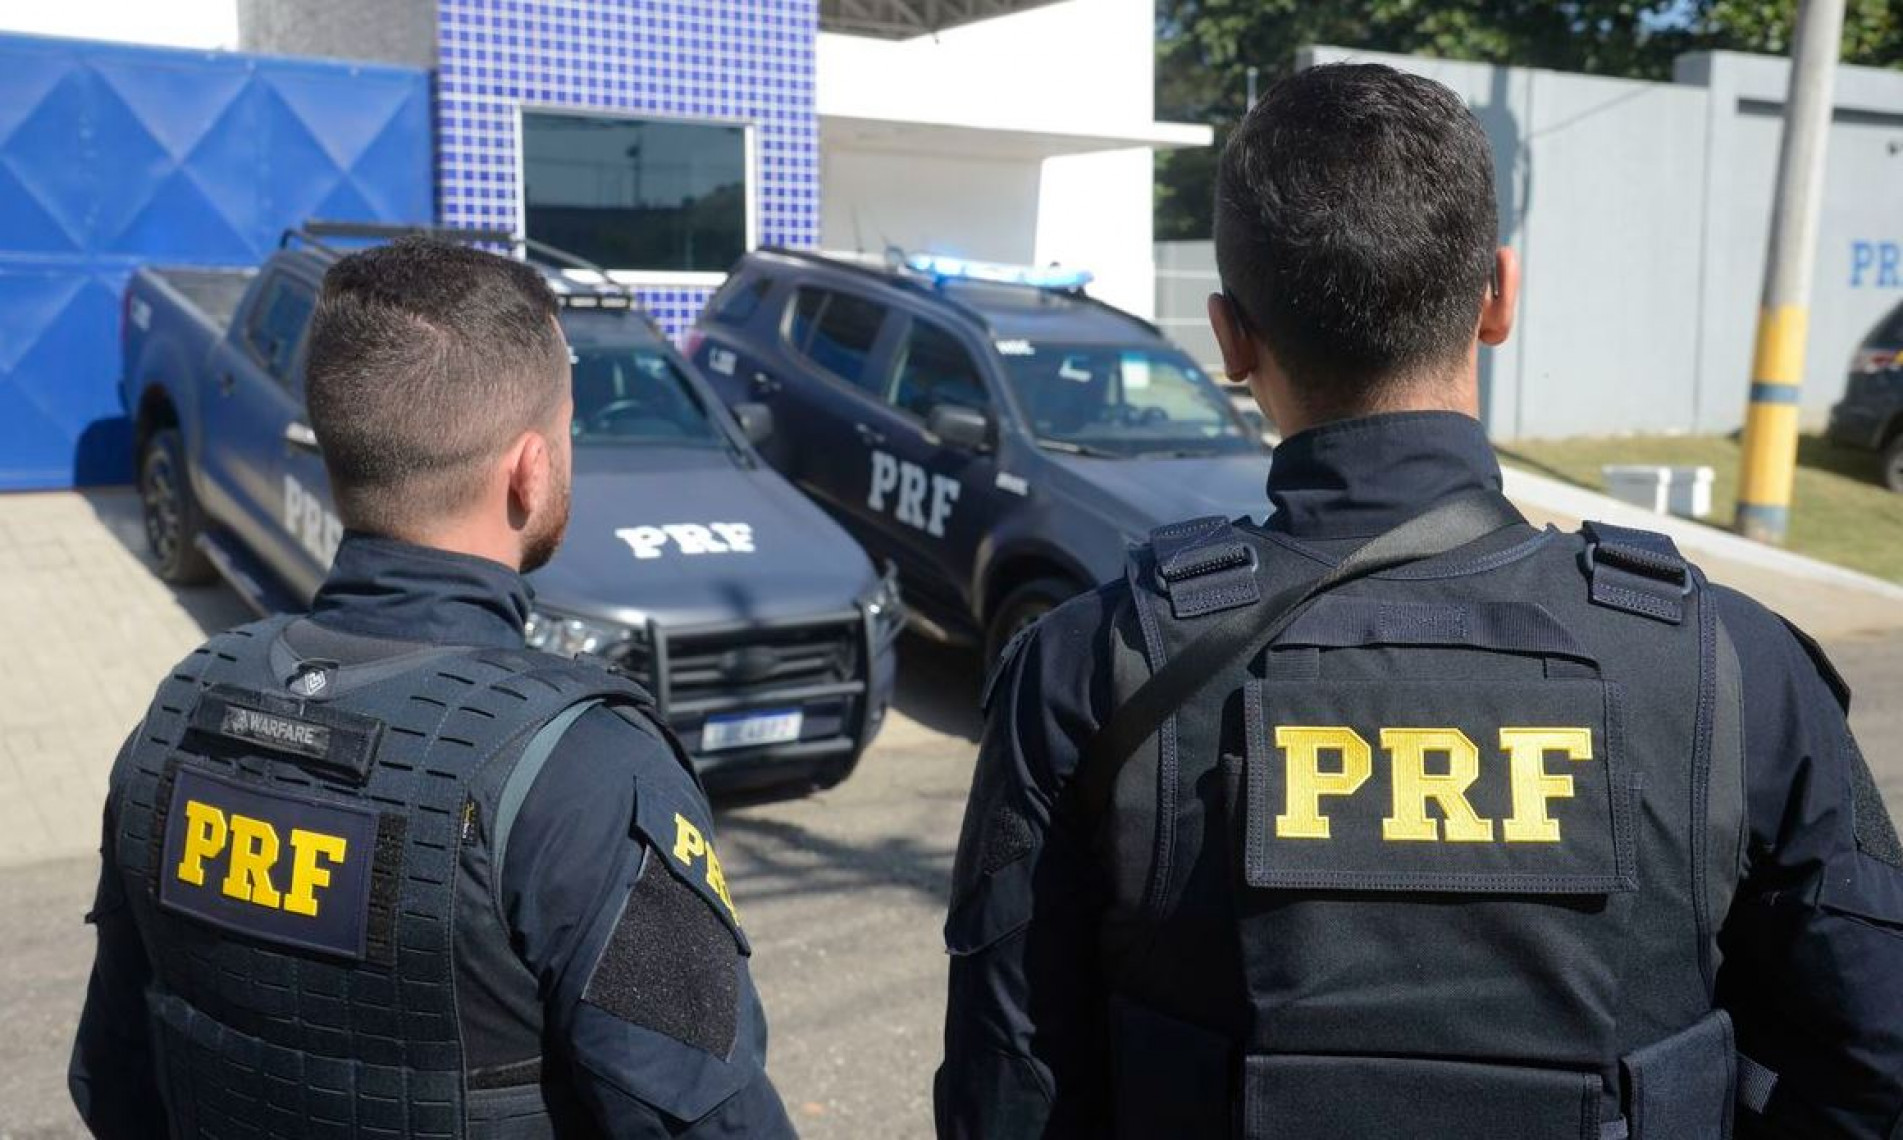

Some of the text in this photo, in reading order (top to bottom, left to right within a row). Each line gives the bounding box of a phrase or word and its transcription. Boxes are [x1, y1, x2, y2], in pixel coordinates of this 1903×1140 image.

[615, 522, 755, 558] PRF
[863, 451, 961, 538] PRF
[251, 711, 314, 744] WARFARE
[1275, 726, 1593, 842] PRF
[178, 800, 347, 916] PRF
[673, 812, 740, 926] PR
